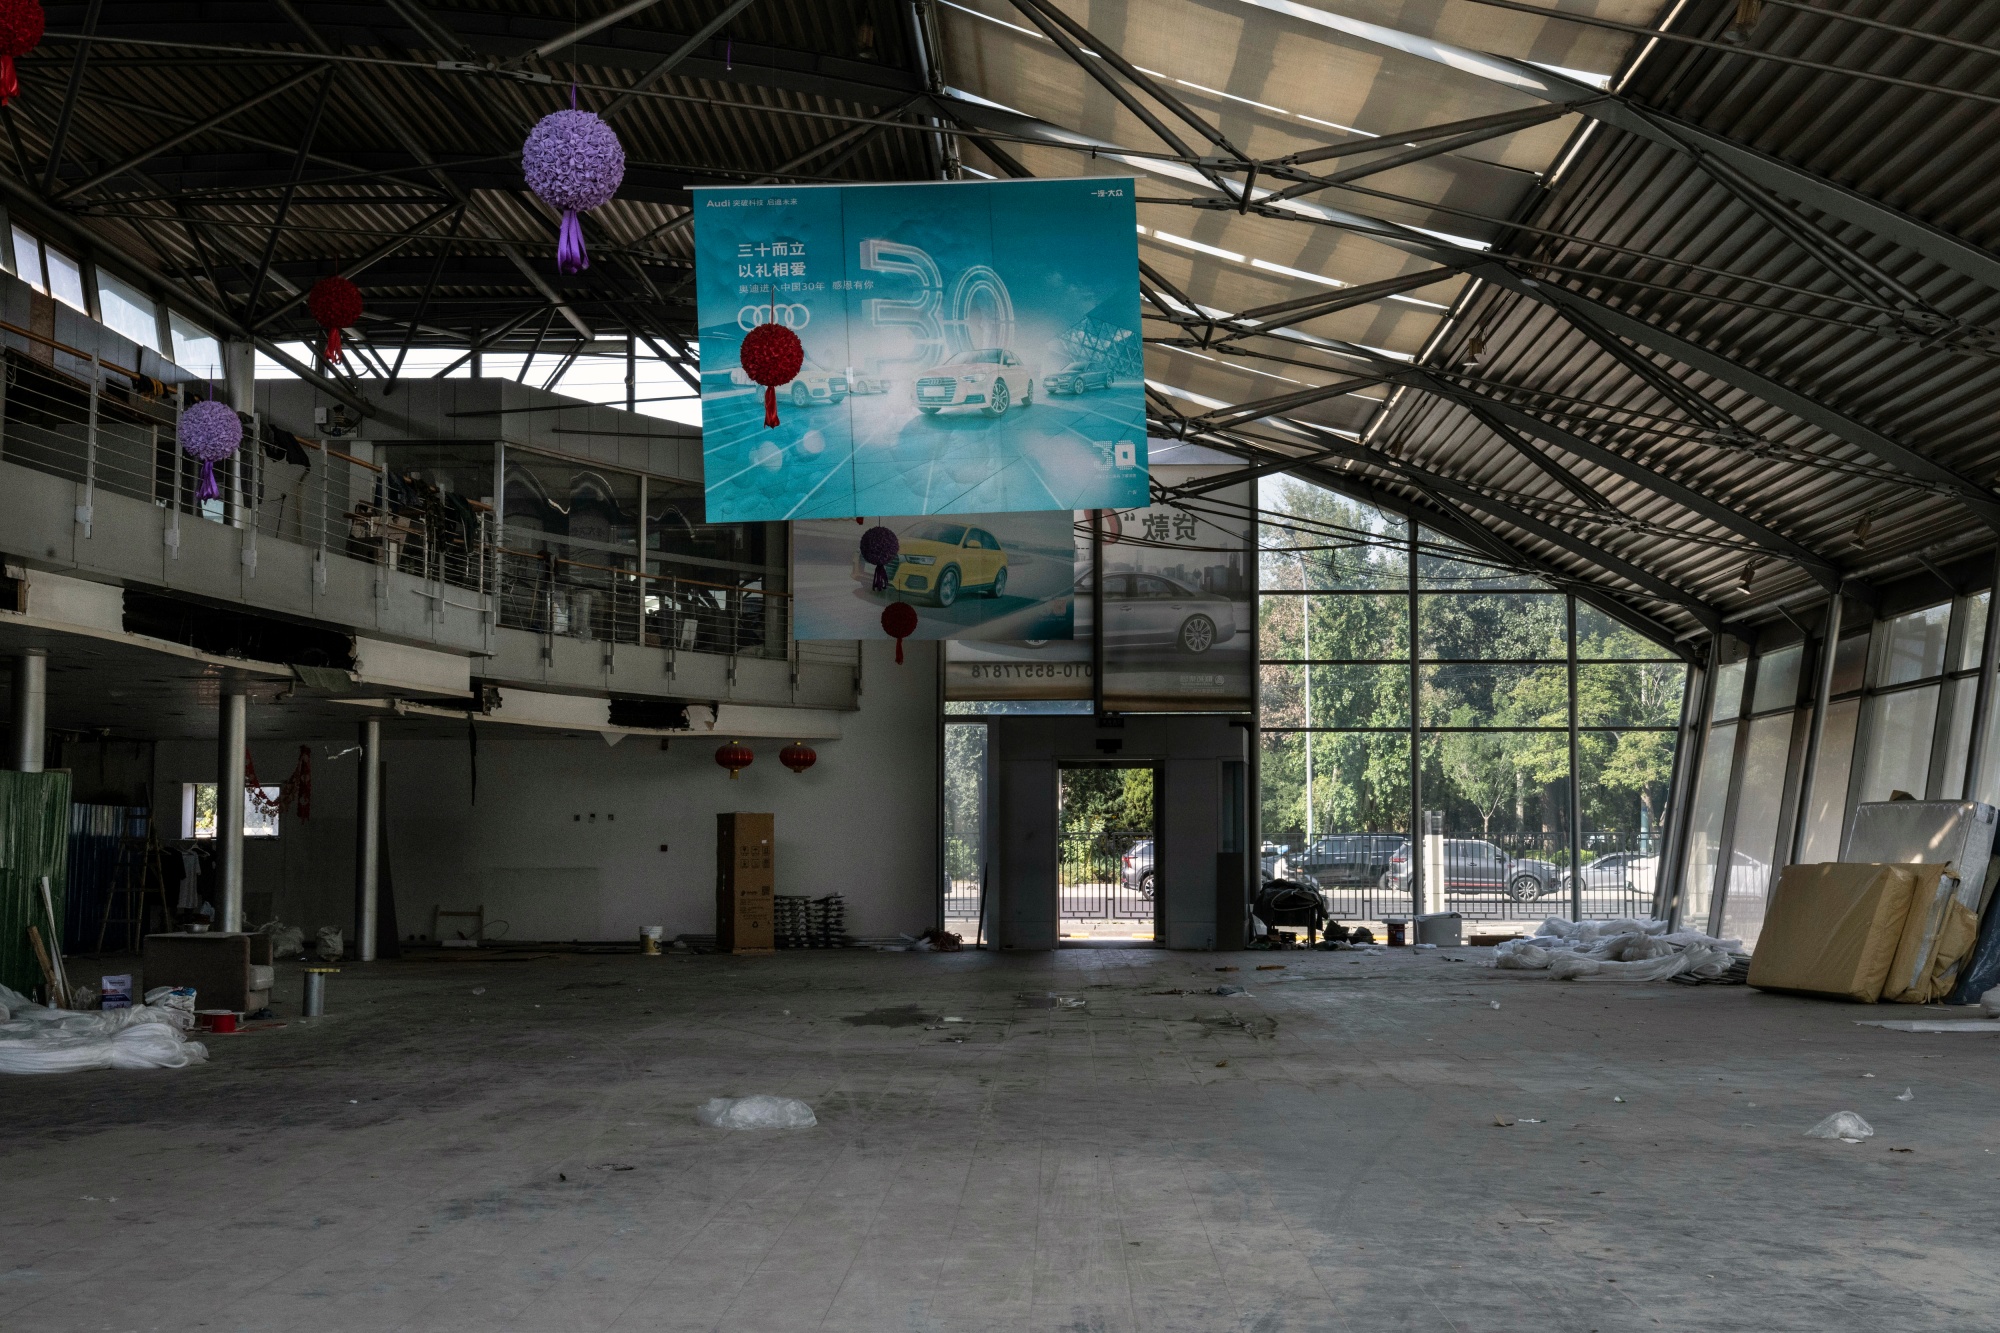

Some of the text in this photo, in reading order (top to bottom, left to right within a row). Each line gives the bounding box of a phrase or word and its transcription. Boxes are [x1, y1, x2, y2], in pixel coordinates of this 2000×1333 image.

[706, 199, 731, 208] Audi
[738, 242, 806, 258] 三十而立
[738, 261, 806, 278] 以礼相爱
[738, 279, 874, 294] 奥迪进入中国30年 感恩有你
